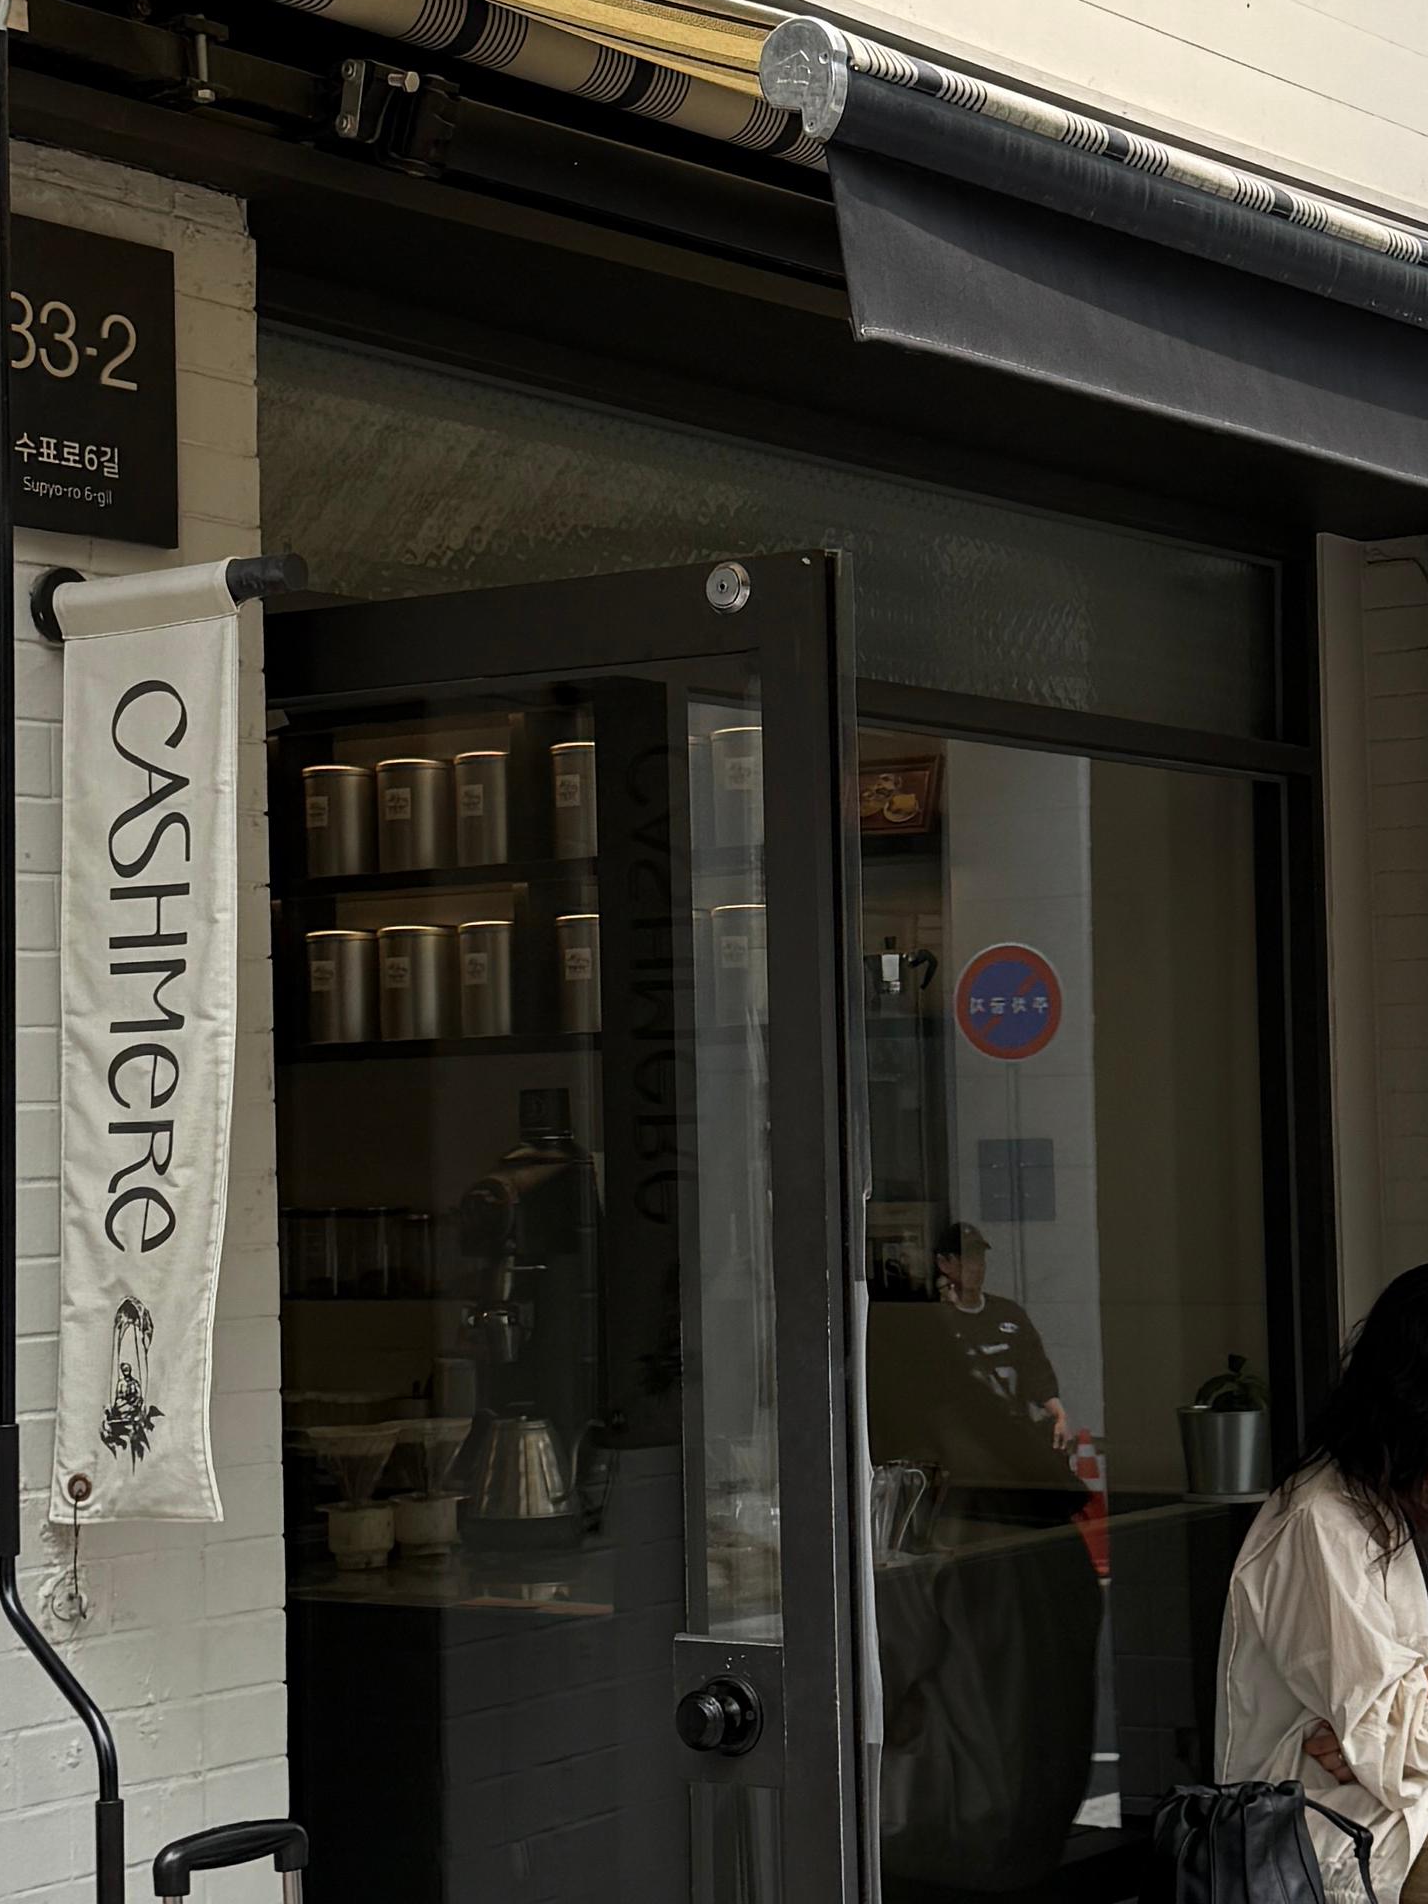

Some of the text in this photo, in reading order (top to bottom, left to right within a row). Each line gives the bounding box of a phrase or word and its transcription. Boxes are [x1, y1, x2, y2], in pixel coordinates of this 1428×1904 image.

[12, 429, 121, 481] 수표로6길
[22, 472, 113, 508] Supyo-ro 6-gil
[106, 678, 192, 1254] CASHMERE
